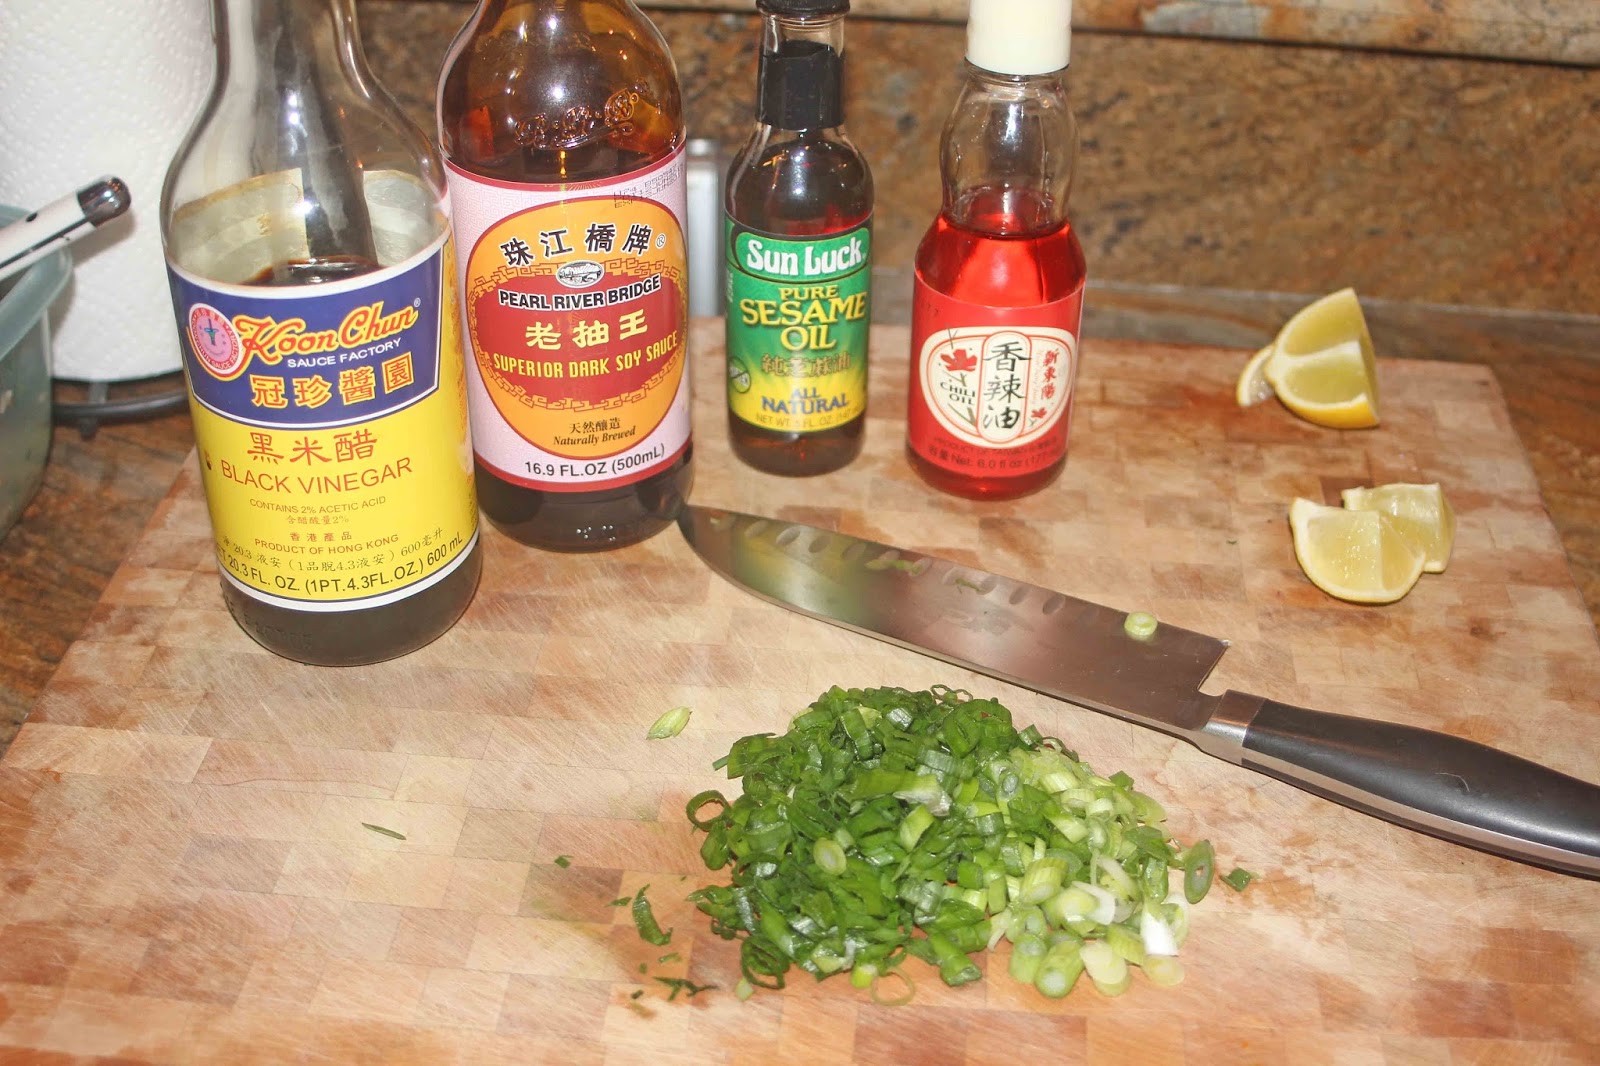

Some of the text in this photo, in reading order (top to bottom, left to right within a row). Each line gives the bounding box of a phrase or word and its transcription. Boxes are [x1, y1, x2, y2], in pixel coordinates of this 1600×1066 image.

[500, 223, 653, 267] 珠江橋牌
[747, 237, 862, 276] Sun Luck
[499, 275, 660, 310] PEARL RIVER BRIDGE
[740, 291, 868, 327] SESAME
[779, 285, 839, 300] PURE
[234, 315, 337, 365] Koon
[338, 301, 418, 348] Chun
[525, 308, 648, 350] 老抽王
[780, 325, 837, 351] OIL
[287, 338, 401, 368] SAUCE FACTORY
[493, 332, 678, 378] SUPERIOR DARK SOY SAUCE
[250, 352, 415, 409] 冠珍醬園
[791, 387, 820, 400] ALL
[940, 381, 976, 398] CHILI
[983, 341, 1031, 429] 香辣油
[762, 393, 848, 415] NATURAL
[949, 393, 976, 406] OIL
[247, 429, 378, 466] 黑米醋
[553, 425, 636, 446] Naturally Brewed
[221, 457, 413, 494] BLACK VINEGAR
[525, 461, 555, 476] 16.9
[612, 442, 665, 475] (500mL)
[249, 496, 386, 514] CONTAINS 2% ACETIC ACID
[255, 534, 399, 555] PRODUCT OF HONG KONG
[290, 531, 352, 542] 香港產品
[228, 554, 249, 577] 20.3
[250, 567, 271, 586] FL.
[275, 575, 300, 591] OZ.
[427, 544, 447, 566] 600
[449, 531, 463, 552] mL
